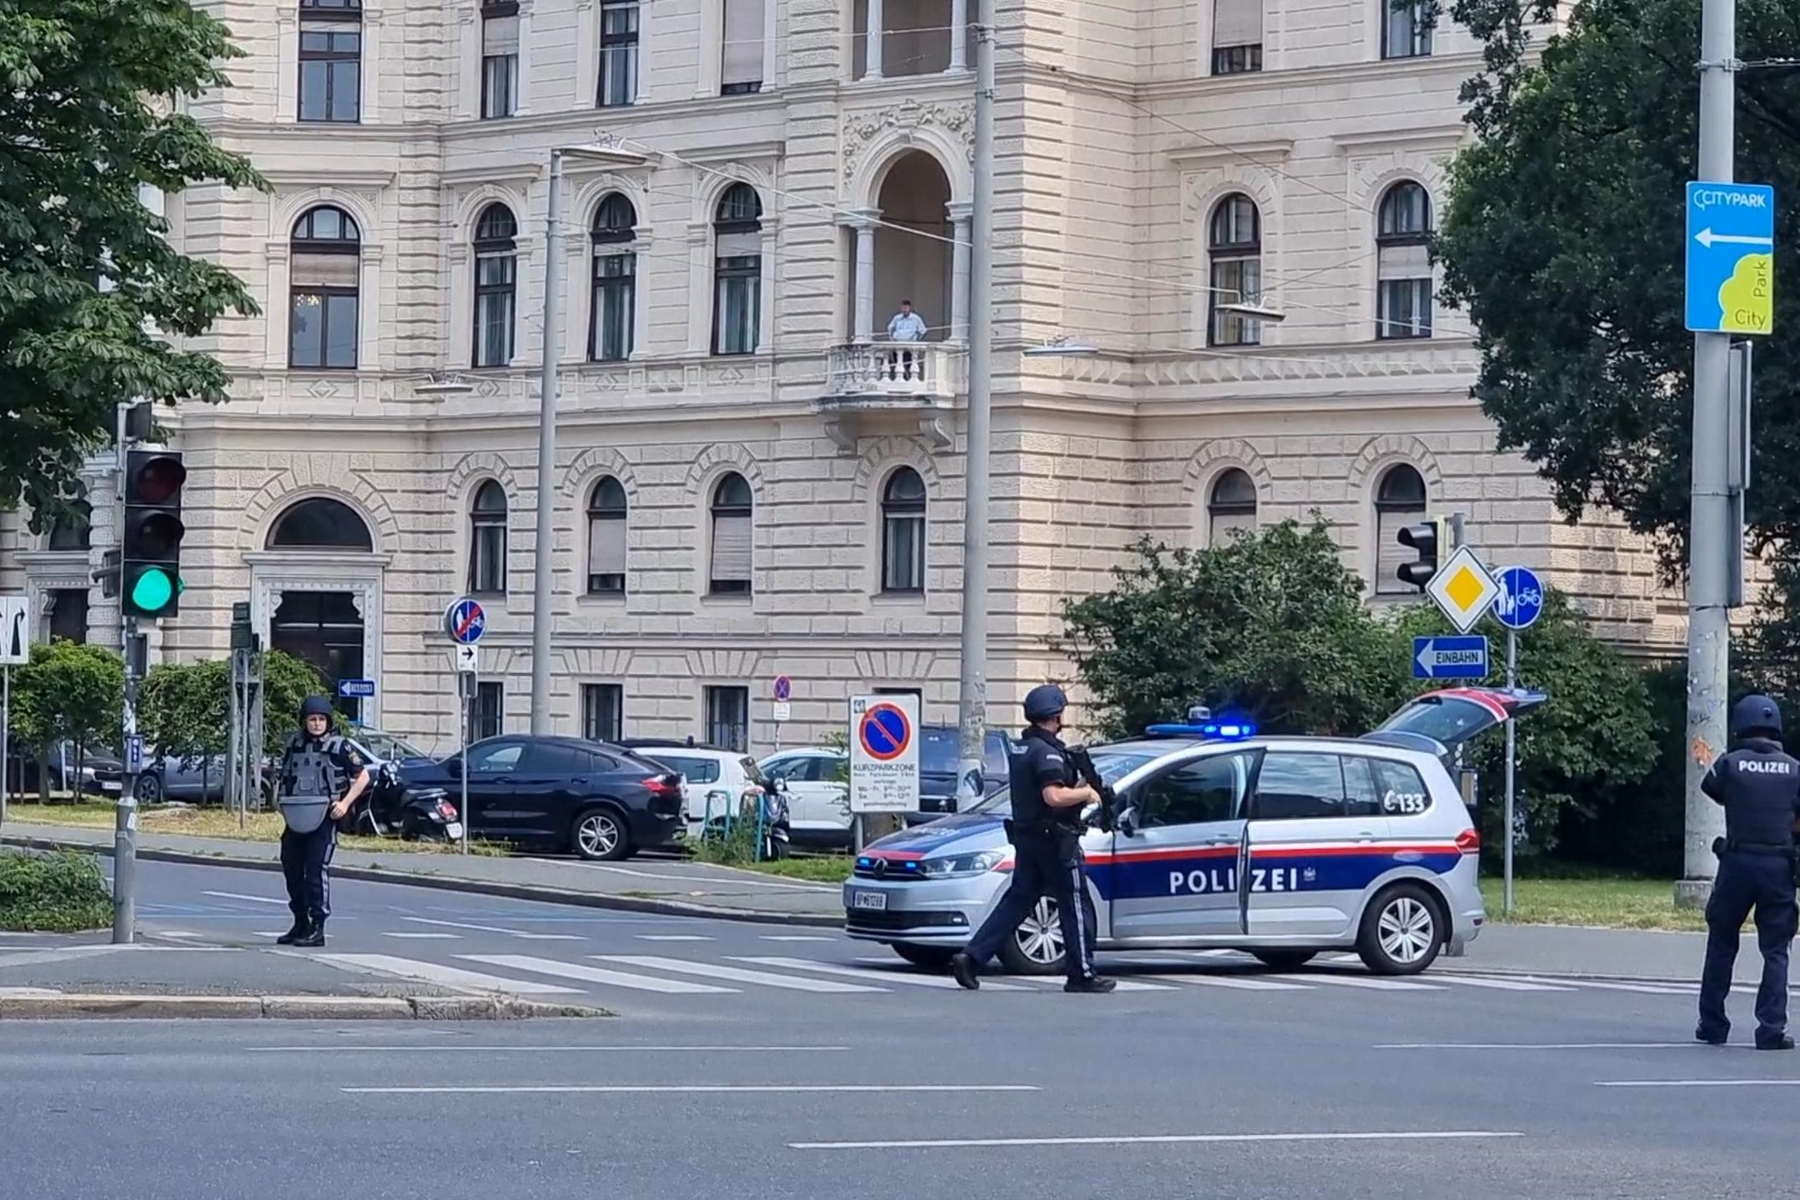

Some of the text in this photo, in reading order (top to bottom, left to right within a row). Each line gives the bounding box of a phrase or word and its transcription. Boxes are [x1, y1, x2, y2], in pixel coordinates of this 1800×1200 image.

[1752, 261, 1767, 298] Park
[1735, 308, 1766, 331] City
[1436, 651, 1479, 664] EINBAHN
[853, 763, 916, 771] KURZPARKZONE
[1738, 760, 1790, 774] POLIZEI
[1397, 793, 1425, 812] 133
[1169, 867, 1298, 894] POLIZEI
